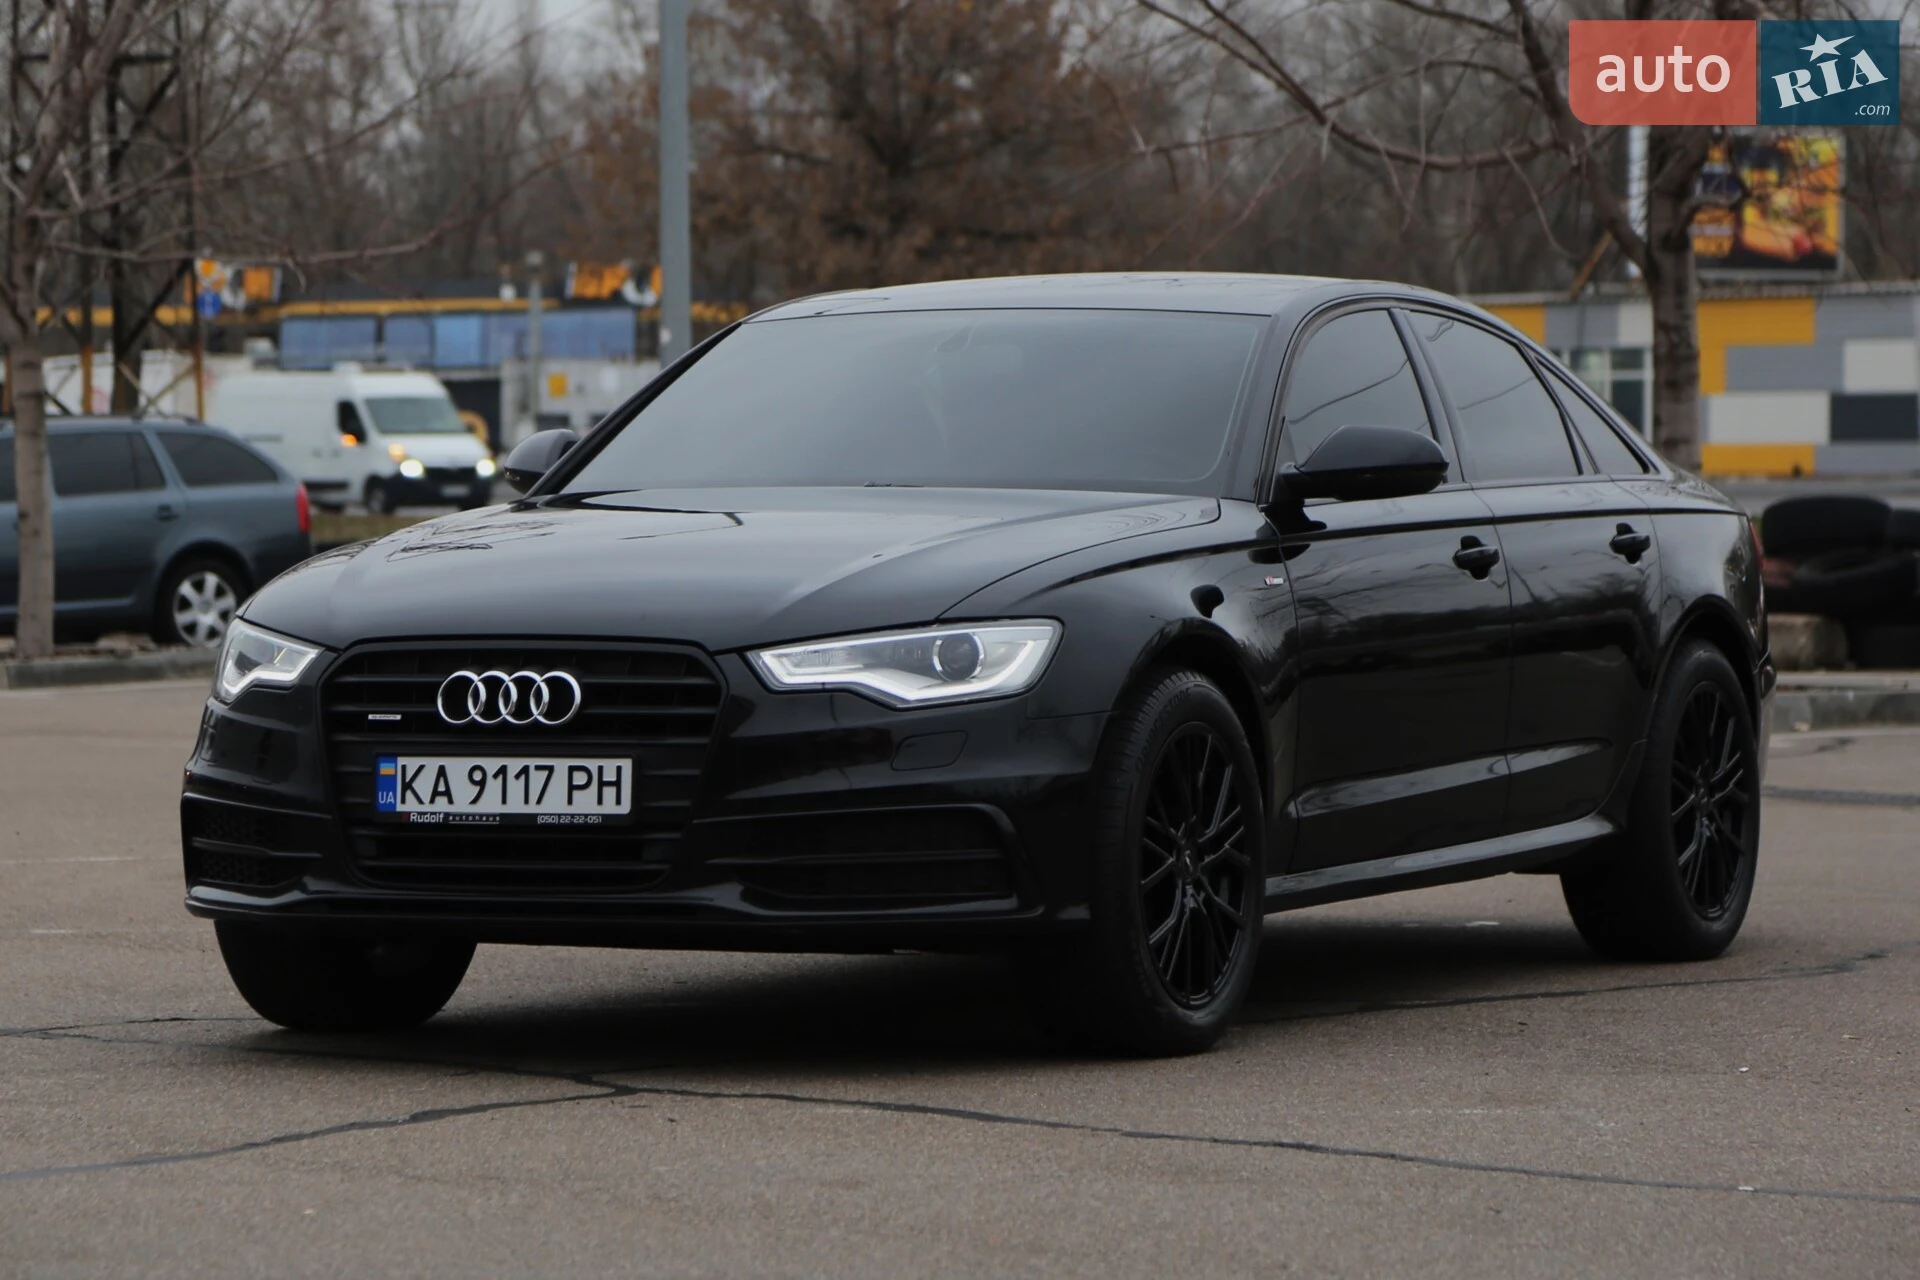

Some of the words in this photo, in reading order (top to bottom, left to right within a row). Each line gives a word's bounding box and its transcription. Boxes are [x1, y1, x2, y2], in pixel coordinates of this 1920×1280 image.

[400, 764, 454, 805] KA
[467, 764, 555, 805] 9117
[567, 765, 622, 806] PH
[378, 792, 395, 804] UA
[410, 813, 444, 823] Rudolf
[537, 815, 559, 824] (050)
[560, 815, 602, 824] 22-22-051
